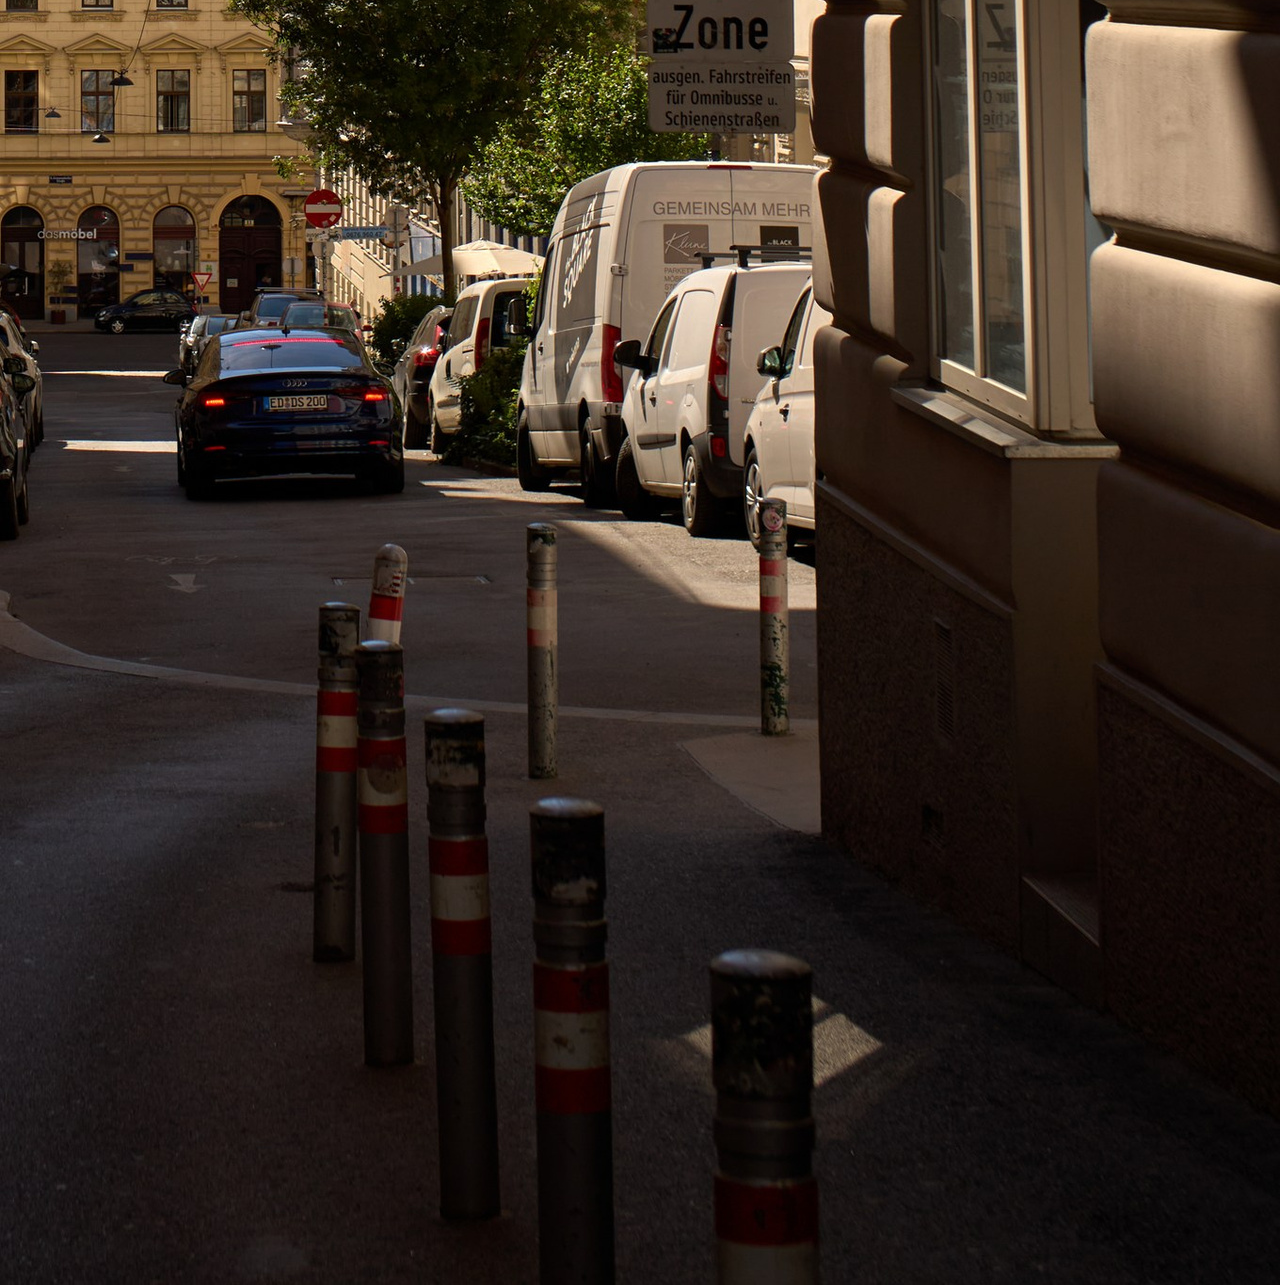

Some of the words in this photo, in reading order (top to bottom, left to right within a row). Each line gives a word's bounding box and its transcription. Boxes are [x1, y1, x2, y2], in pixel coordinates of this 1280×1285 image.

[673, 4, 769, 50] Zone
[652, 70, 705, 87] ausgen.
[709, 69, 791, 85] Fahrstreifen
[666, 89, 687, 105] für
[690, 89, 763, 106] Omnibusse
[767, 97, 778, 106] u.
[665, 110, 780, 127] Schienenstraßen
[652, 200, 757, 217] GEMEINSAM
[761, 202, 811, 218] MEHR
[37, 227, 97, 240] dasmöbel
[270, 397, 284, 408] ED
[291, 396, 305, 408] DS
[306, 395, 326, 407] 200
